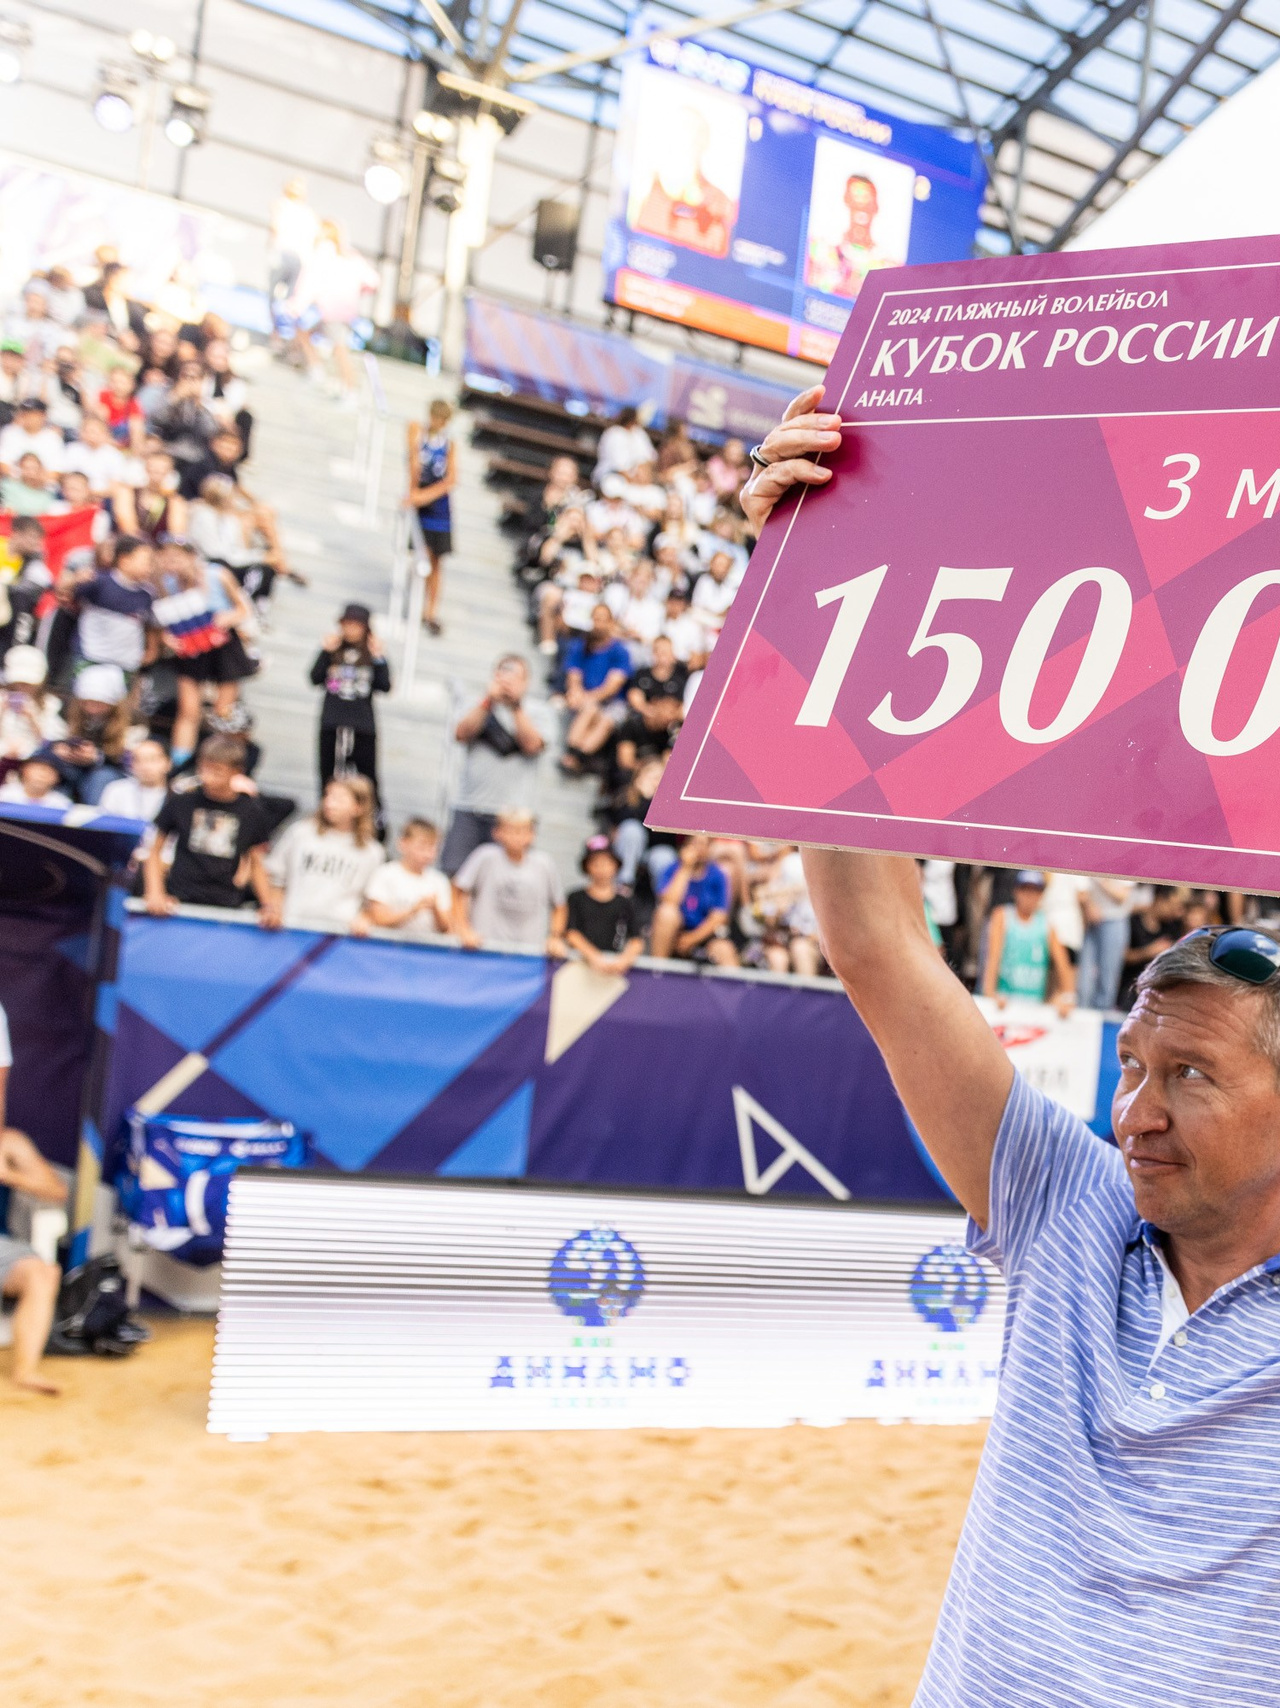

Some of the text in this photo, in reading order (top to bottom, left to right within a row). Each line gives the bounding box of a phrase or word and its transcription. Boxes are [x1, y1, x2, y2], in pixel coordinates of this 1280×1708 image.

[887, 289, 1169, 327] 2024 ПЛЯЖНЫЙ ВОЛЕЙБОЛ
[869, 315, 1280, 378] КУБОК РОССИИ
[854, 387, 924, 408] АНАПА
[1143, 453, 1201, 520] 3
[794, 563, 1133, 745] 150
[865, 1359, 1000, 1388] ДИНАМ
